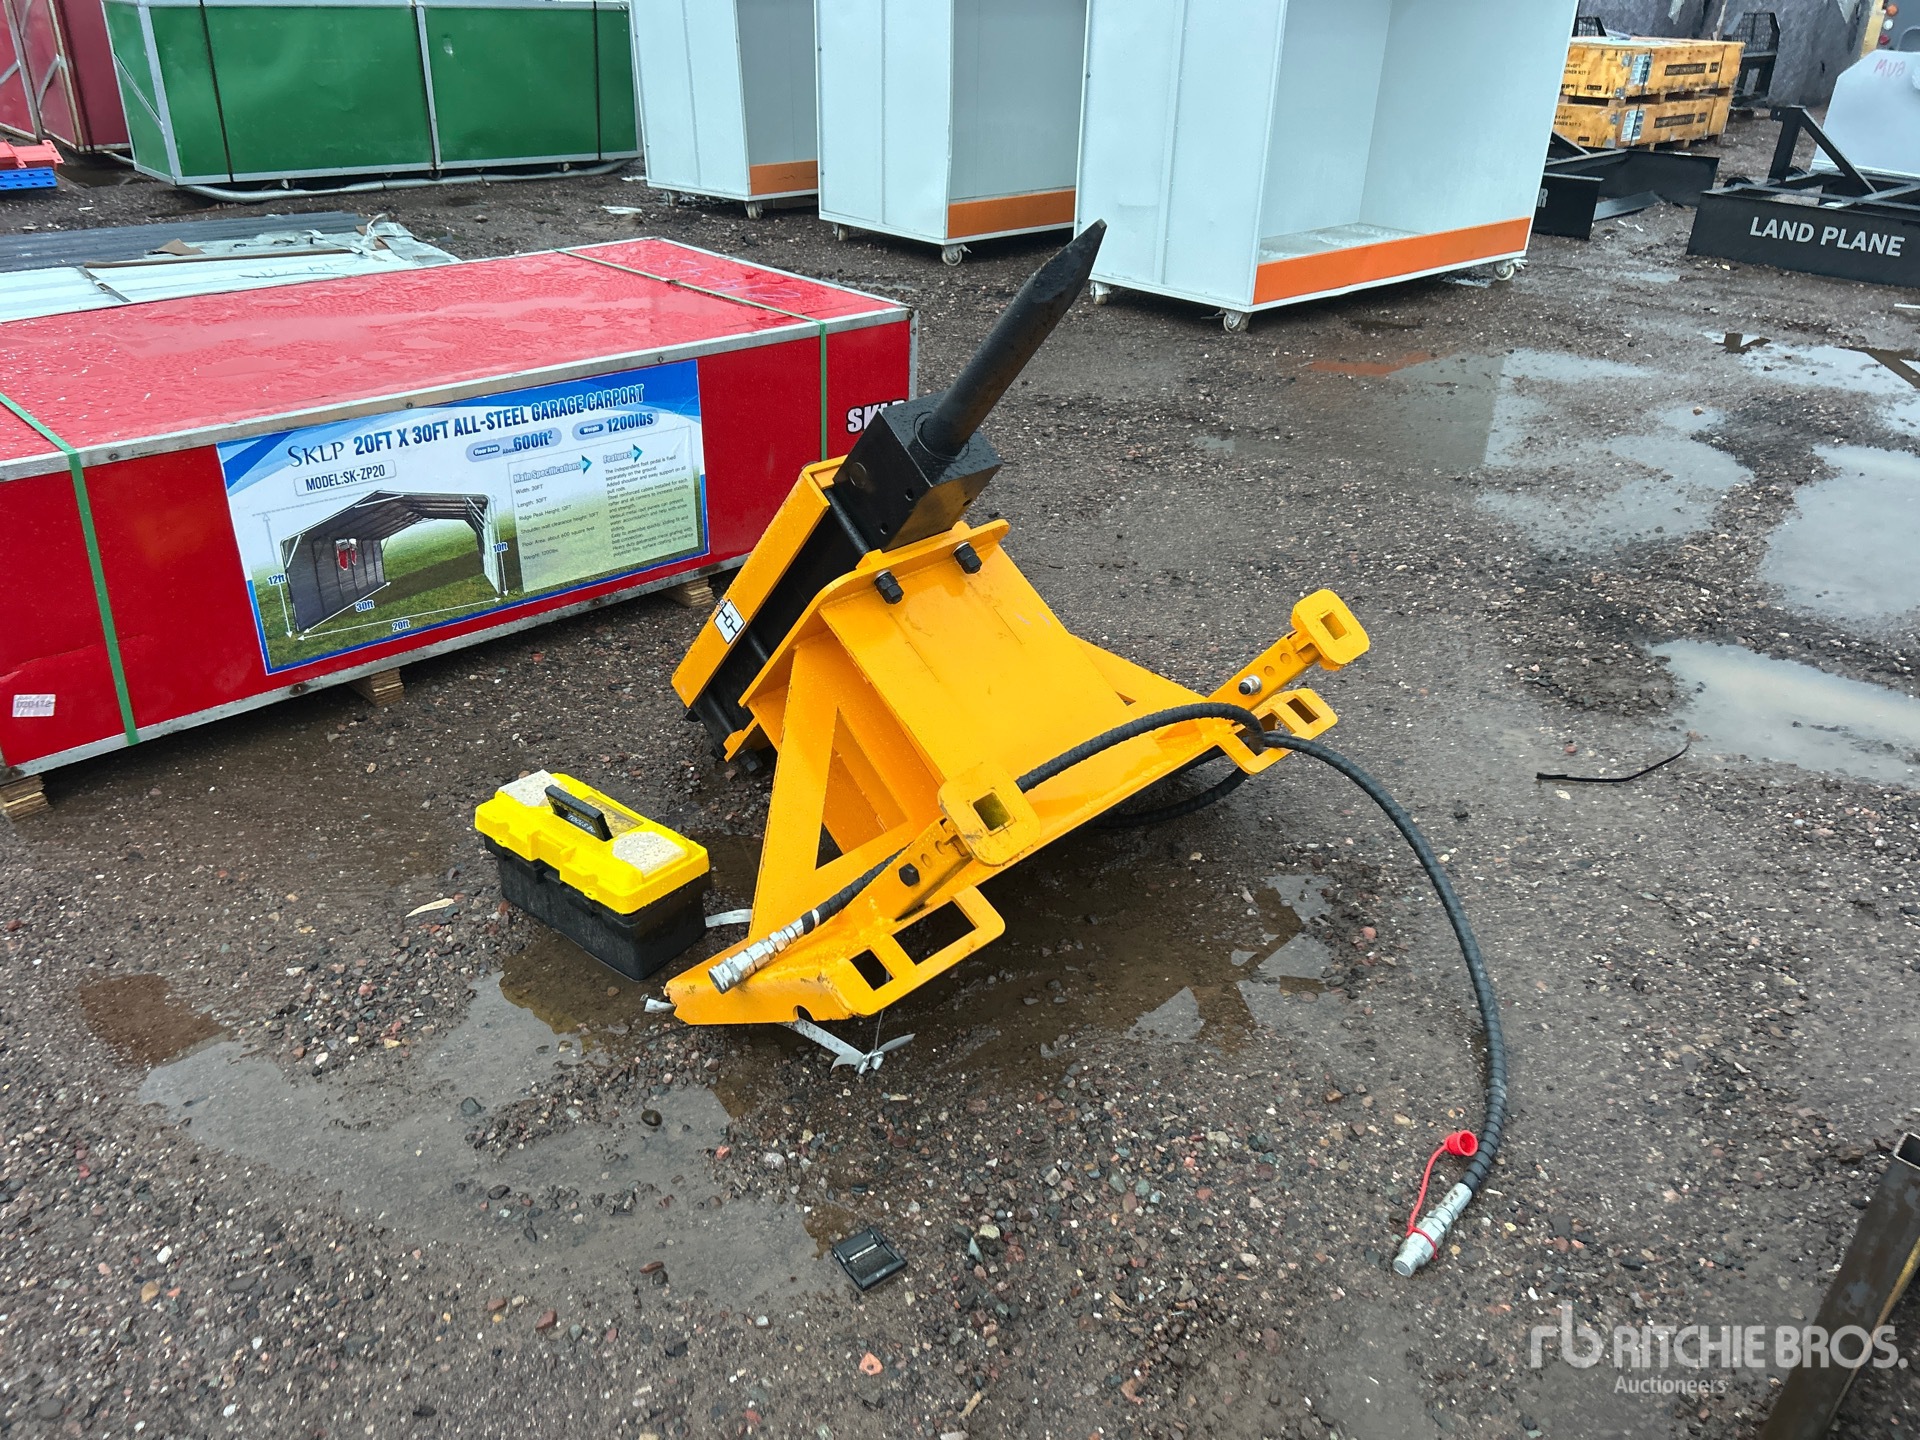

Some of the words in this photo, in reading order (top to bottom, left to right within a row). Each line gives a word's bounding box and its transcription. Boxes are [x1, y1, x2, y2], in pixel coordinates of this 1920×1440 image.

[1750, 216, 1815, 243] LAND
[1820, 226, 1906, 257] PLANE
[606, 413, 654, 433] 1200lbs
[846, 399, 905, 433] SK
[287, 441, 345, 467] SKLP
[354, 430, 392, 455] 20FT
[399, 427, 410, 448] X
[413, 420, 449, 444] 30FT
[454, 405, 529, 437] ALL-STEEL
[531, 395, 584, 421] GARAGE
[588, 384, 644, 410] CARPORT
[513, 472, 532, 483] Main
[531, 462, 581, 479] Specifications
[614, 463, 640, 472] independent
[305, 464, 385, 491] MODEL:SK-ZP20
[606, 473, 627, 481] separately
[493, 542, 508, 553] 10ft
[268, 574, 285, 585] 12ft
[355, 600, 375, 612] 30ft
[392, 620, 410, 632] 20ft
